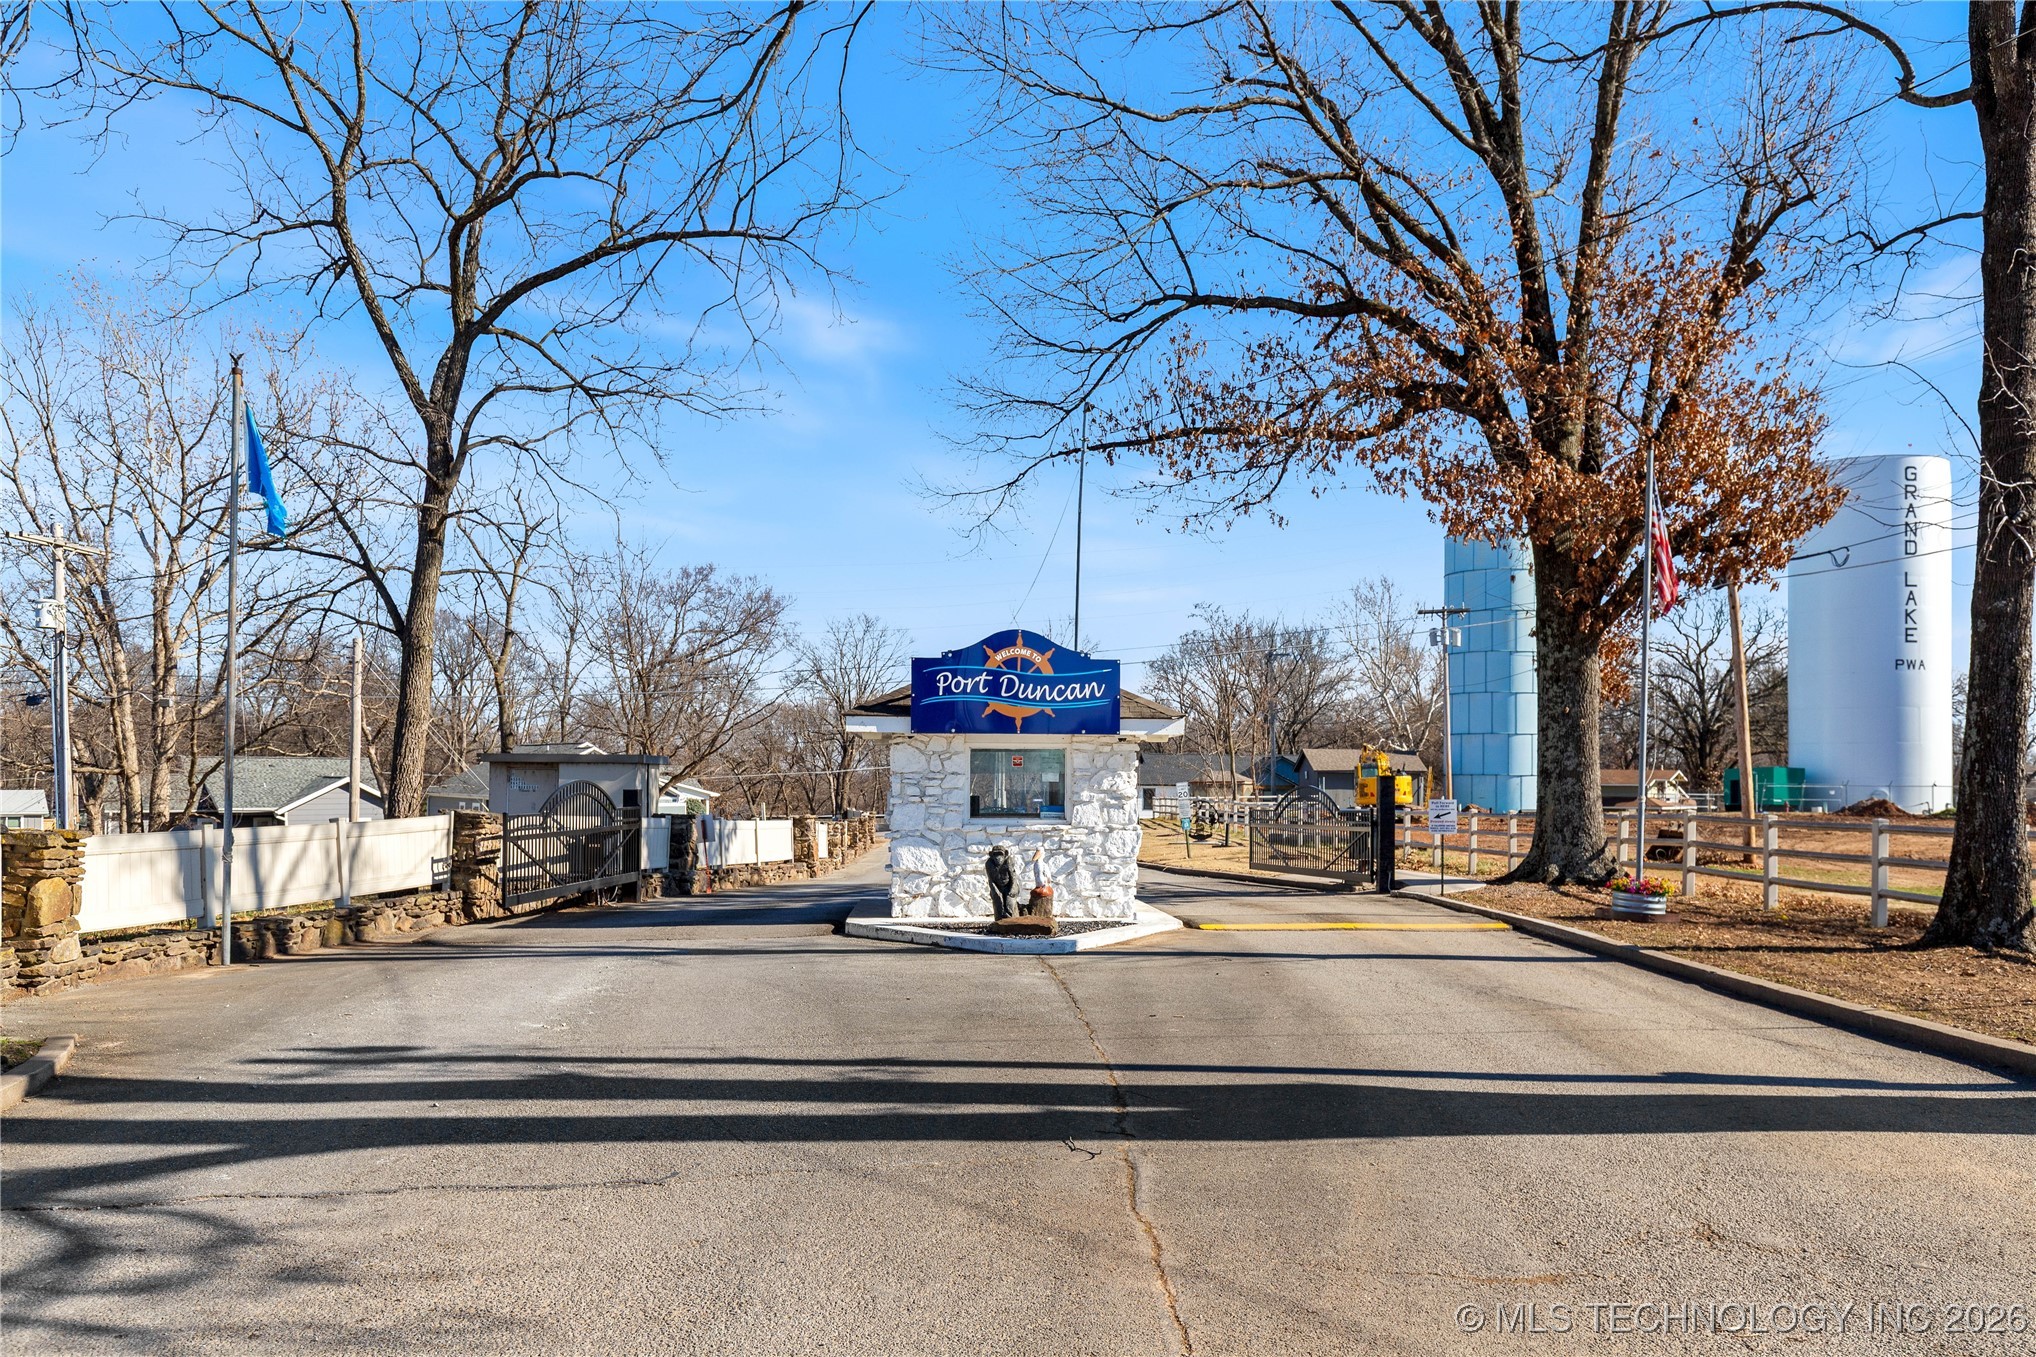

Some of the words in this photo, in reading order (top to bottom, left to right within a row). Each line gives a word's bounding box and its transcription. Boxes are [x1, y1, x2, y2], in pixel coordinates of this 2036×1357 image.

[1904, 466, 1918, 555] GRAND
[1904, 572, 1918, 643] LAKE
[994, 648, 1031, 662] WELCOME
[1031, 653, 1042, 663] TO
[1895, 659, 1926, 670] PWA
[936, 671, 993, 696] Port
[999, 674, 1106, 702] Duncan
